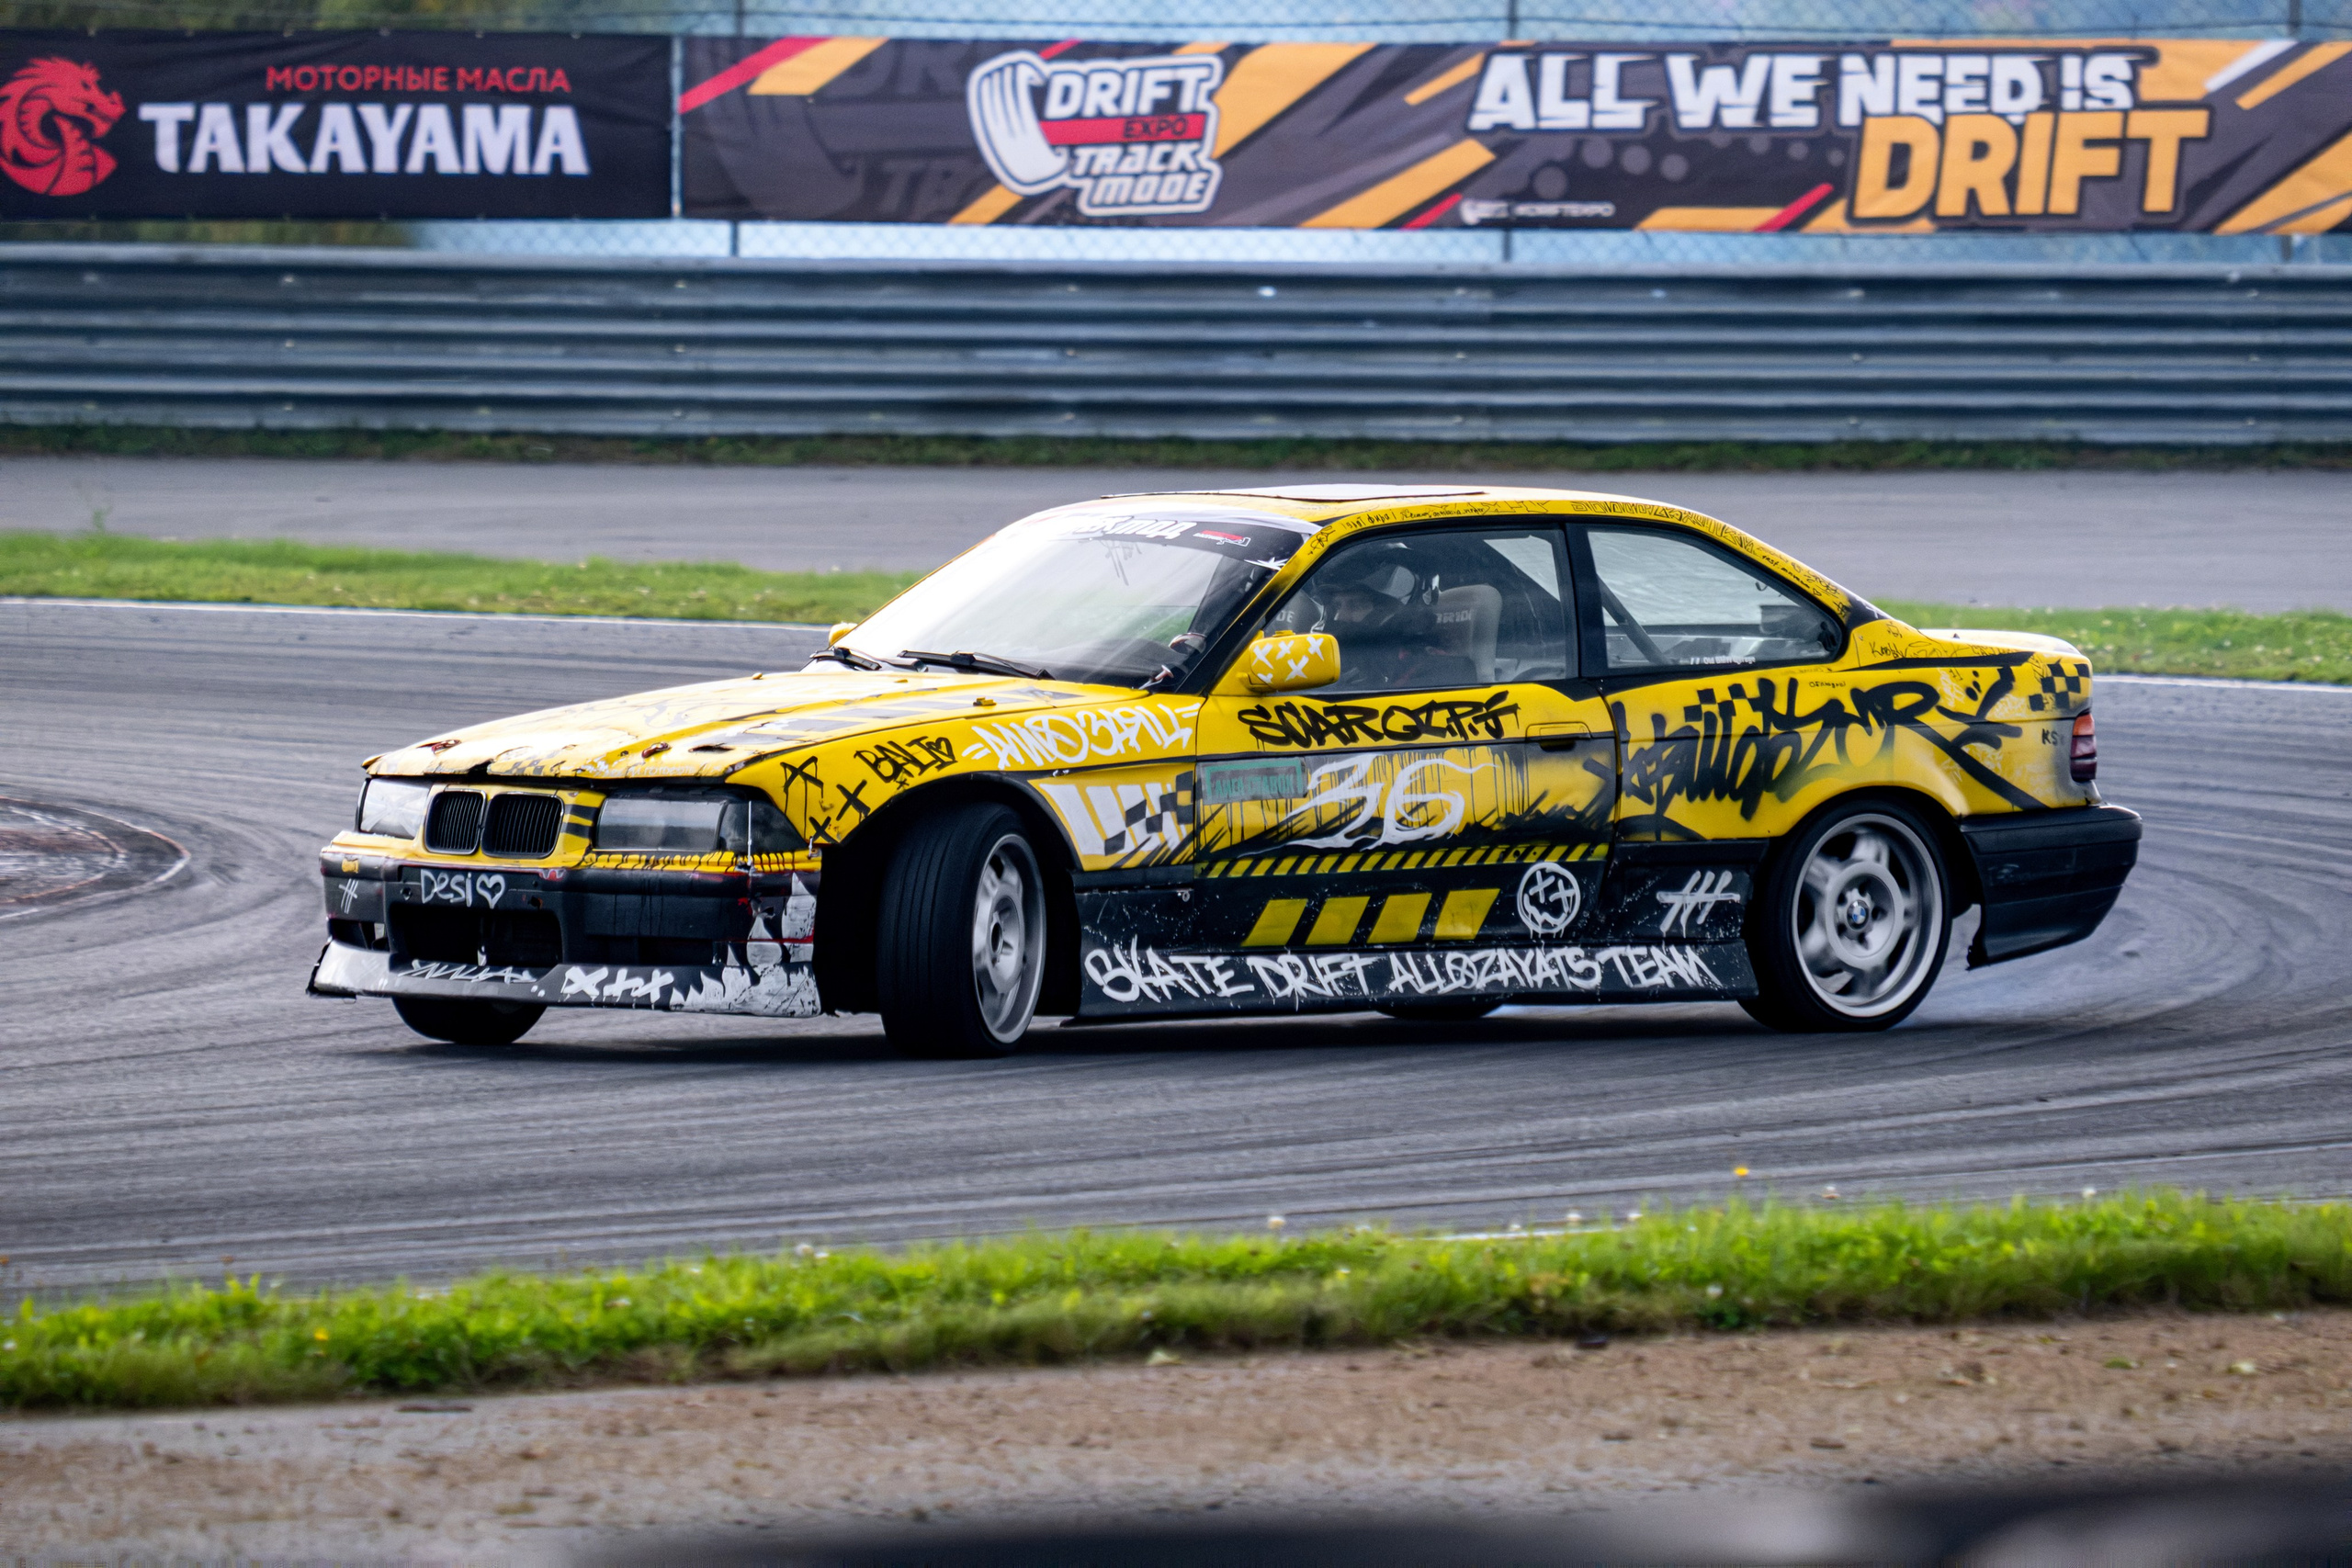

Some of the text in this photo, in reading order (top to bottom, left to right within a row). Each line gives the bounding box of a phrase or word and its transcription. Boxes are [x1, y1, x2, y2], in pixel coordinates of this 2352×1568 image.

[266, 65, 571, 92] МОТОРНЫЕ МАСЛА
[1044, 67, 1212, 119] DRIFT
[1468, 53, 2141, 130] ALL WE NEED IS
[139, 102, 590, 175] TAKAYAMA
[1124, 117, 1189, 137] EXPO
[1091, 173, 1210, 205] MODE
[1852, 108, 2210, 219] DRIFT
[1282, 753, 1499, 851] 36
[1085, 934, 1724, 1003] SKATE DRIFT ALLOZAYATS TEAM
